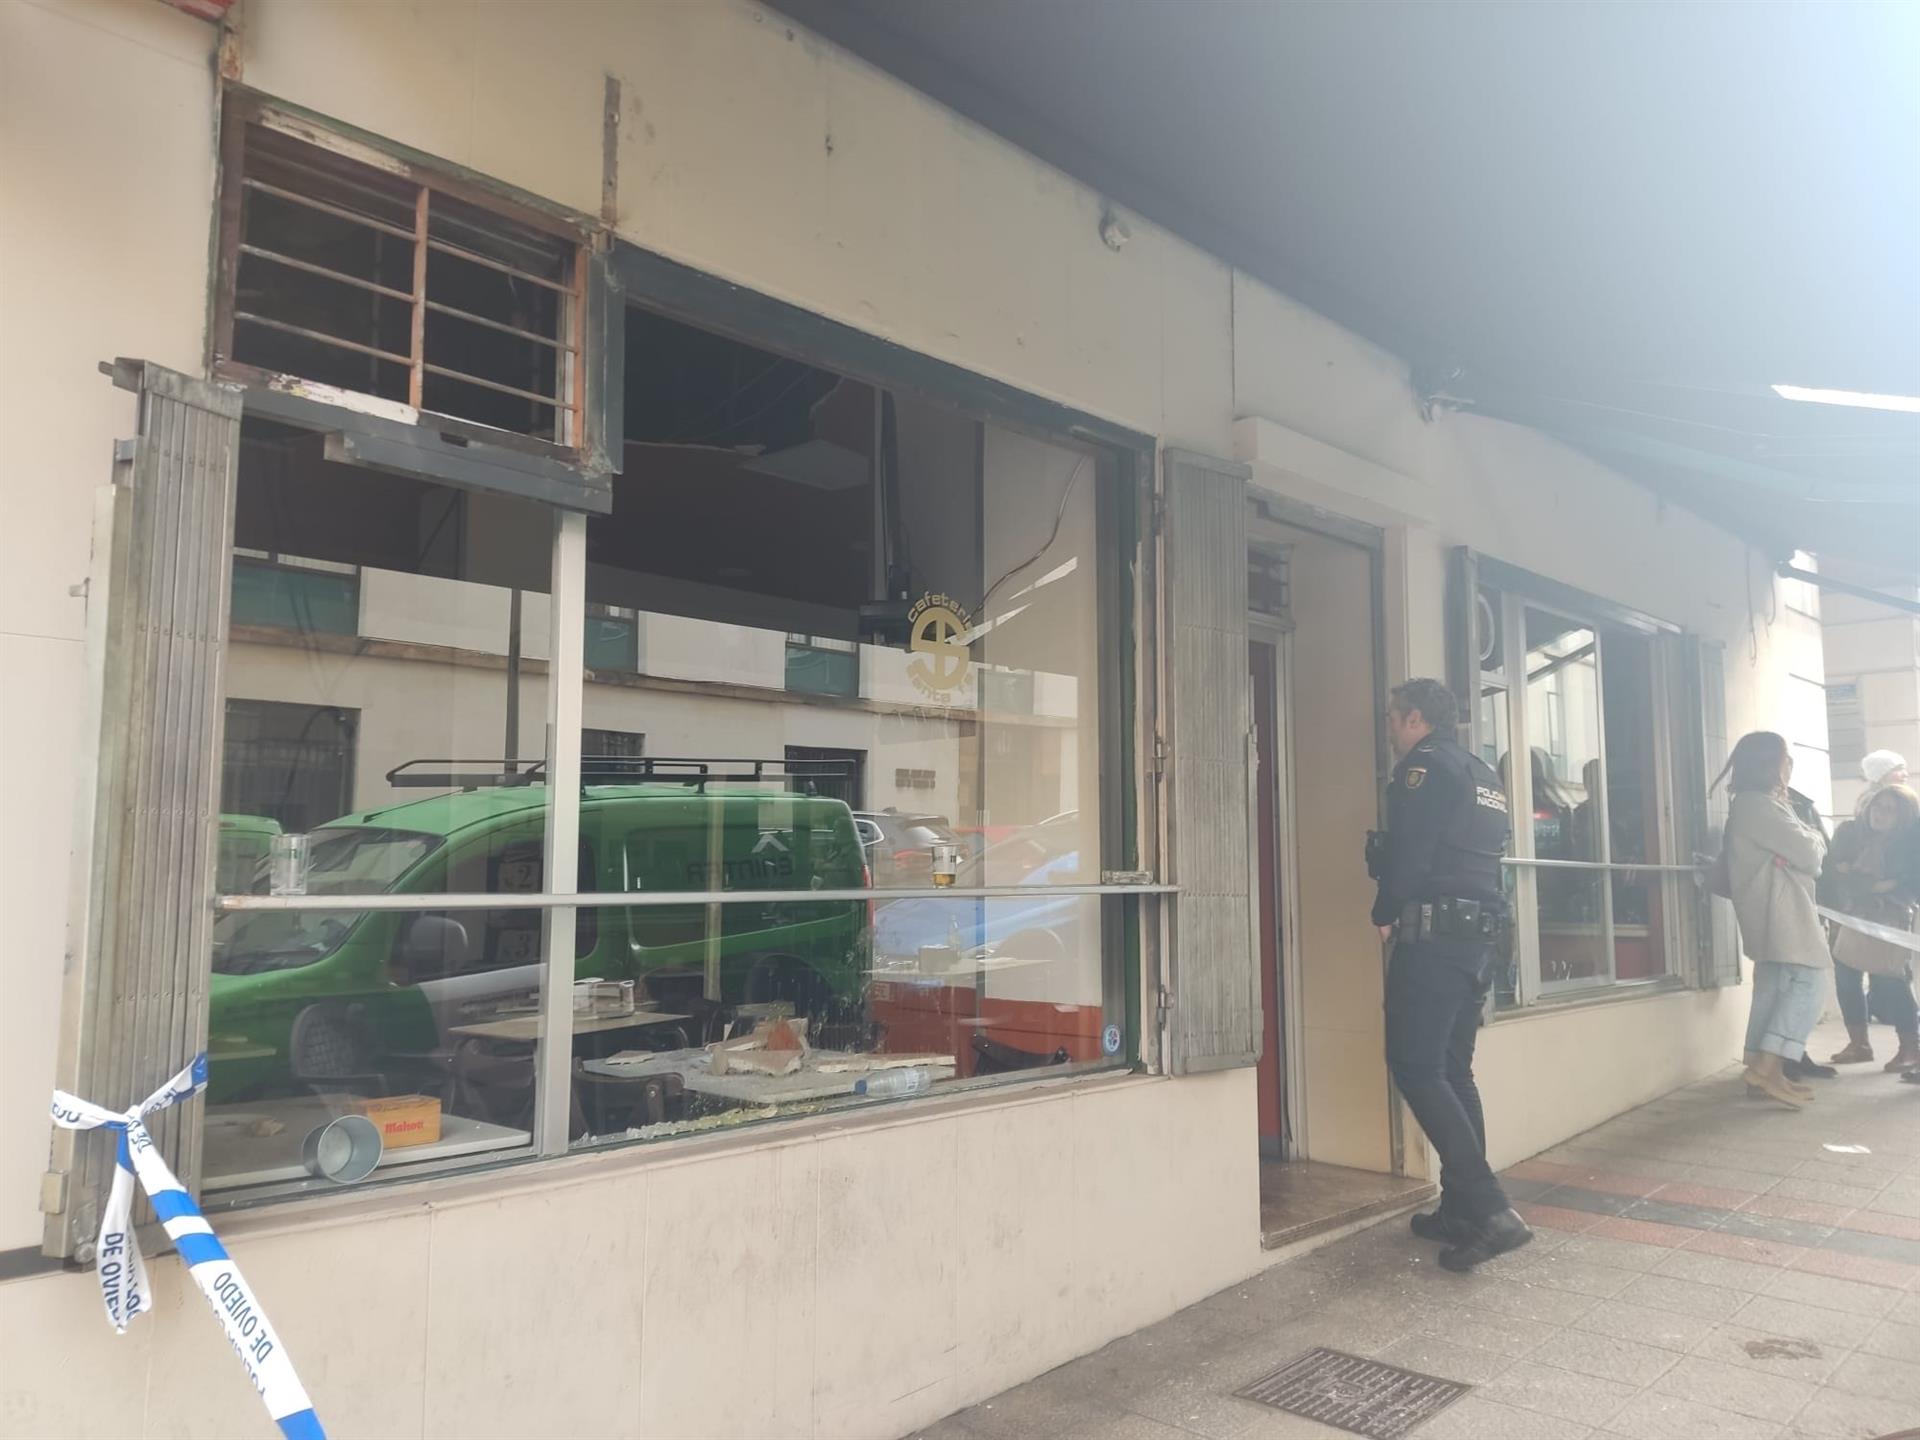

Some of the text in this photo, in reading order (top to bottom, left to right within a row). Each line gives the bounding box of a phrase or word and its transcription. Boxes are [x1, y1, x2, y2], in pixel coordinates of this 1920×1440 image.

[102, 1232, 124, 1258] DE
[213, 1272, 258, 1337] OVIEDO
[249, 1329, 273, 1364] DE
